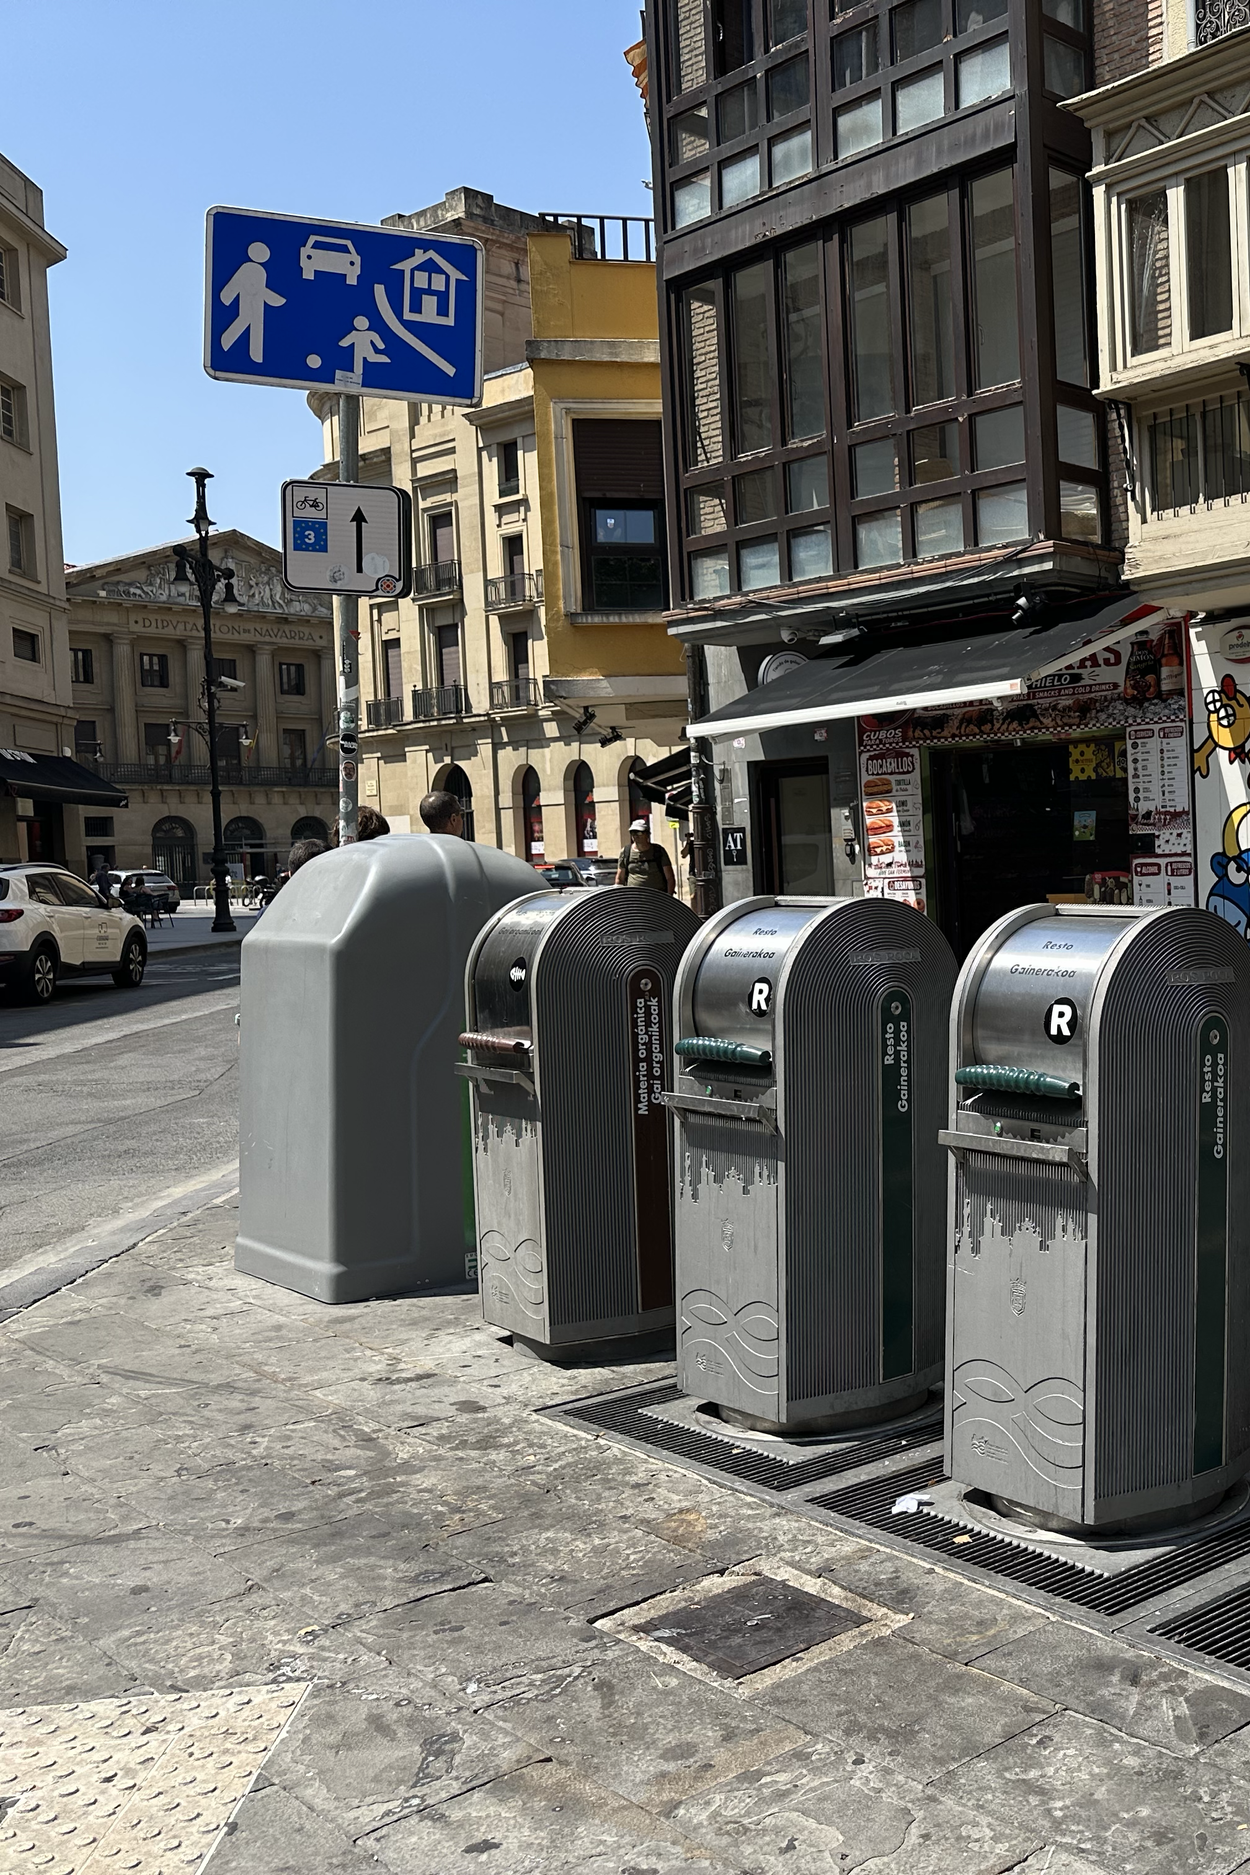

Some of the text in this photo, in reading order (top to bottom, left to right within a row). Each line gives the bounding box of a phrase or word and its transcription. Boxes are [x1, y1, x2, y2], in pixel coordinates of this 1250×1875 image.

[304, 530, 315, 543] 3
[142, 617, 241, 636] DIPVTAION
[253, 627, 316, 643] NAVARRA
[1031, 674, 1071, 688] HIELO
[1035, 689, 1059, 698] SNACKS
[1060, 687, 1073, 695] AND
[1074, 685, 1090, 693] COLD
[1091, 683, 1114, 692] DRINKS
[862, 729, 903, 740] CUBOS
[867, 756, 913, 775] BOCADILLOS
[725, 832, 744, 850] AT
[752, 927, 778, 936] Resto
[724, 948, 776, 959] Gainerakoa
[1042, 941, 1073, 951] Resto
[1010, 963, 1077, 979] Gainerakoa
[751, 982, 769, 1011] R
[1050, 1004, 1073, 1036] R
[647, 996, 664, 1104] Gai organikoak
[884, 1022, 895, 1065] Resto
[633, 998, 649, 1115] Materia orgánica
[897, 1021, 909, 1112] Gainerakoa
[1201, 1054, 1212, 1103] Resto
[1213, 1052, 1225, 1159] Gainerakoa
